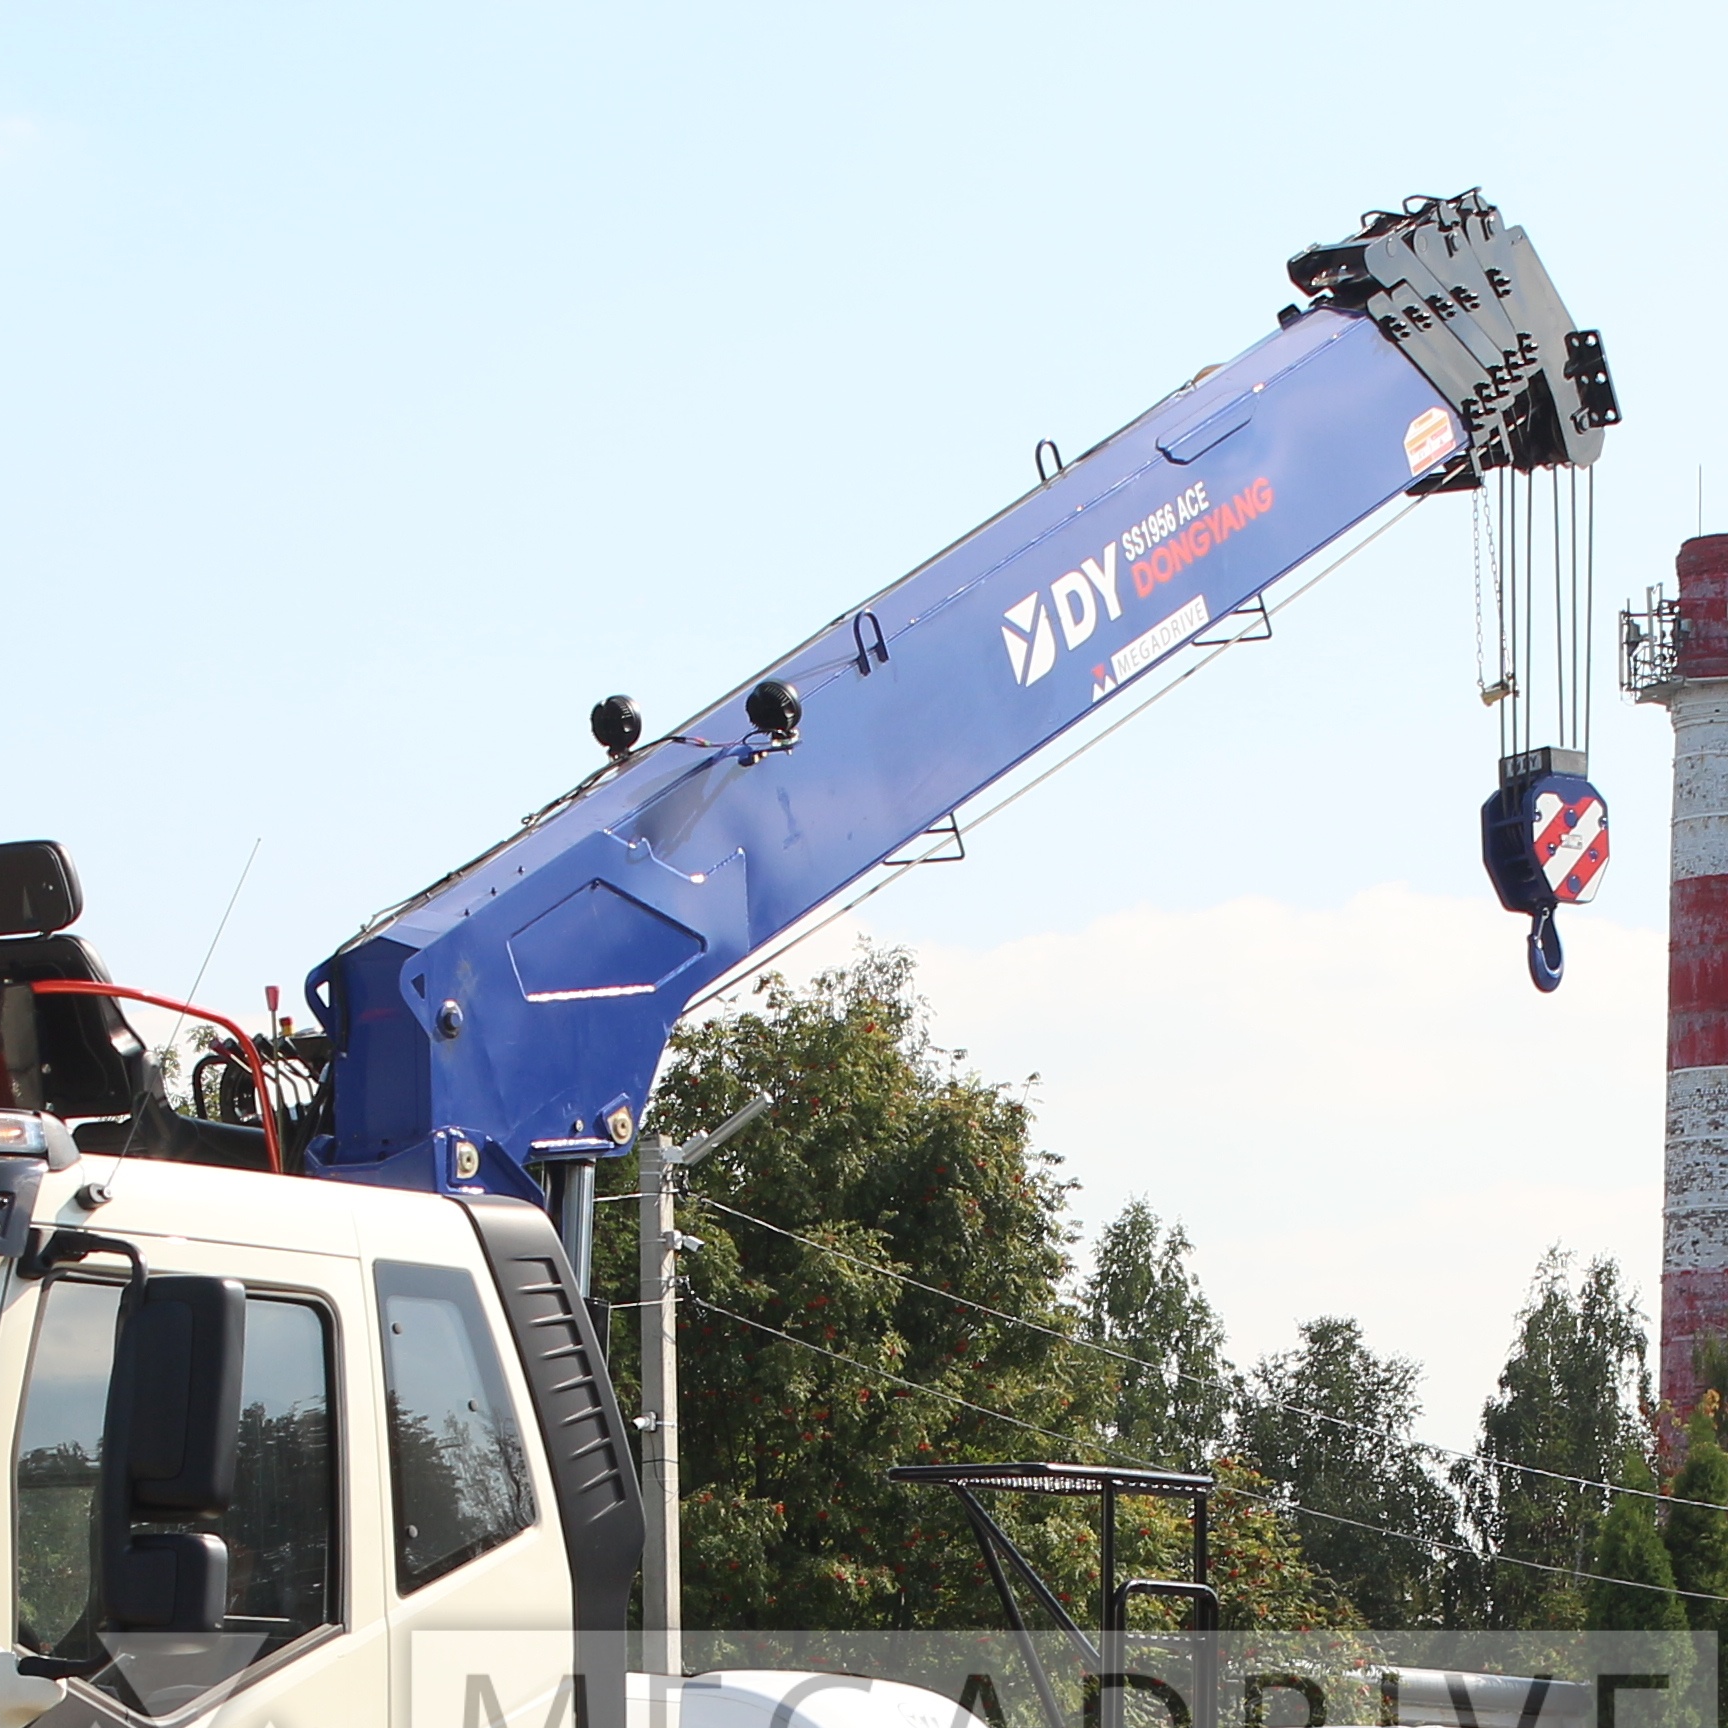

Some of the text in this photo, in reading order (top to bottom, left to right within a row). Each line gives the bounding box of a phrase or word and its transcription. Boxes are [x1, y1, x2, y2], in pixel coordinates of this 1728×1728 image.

[1122, 481, 1210, 561] SS1956 ACE
[1130, 476, 1274, 598] DONGYANG
[1050, 541, 1122, 651] DY
[1116, 600, 1206, 677] MEGADRIVE
